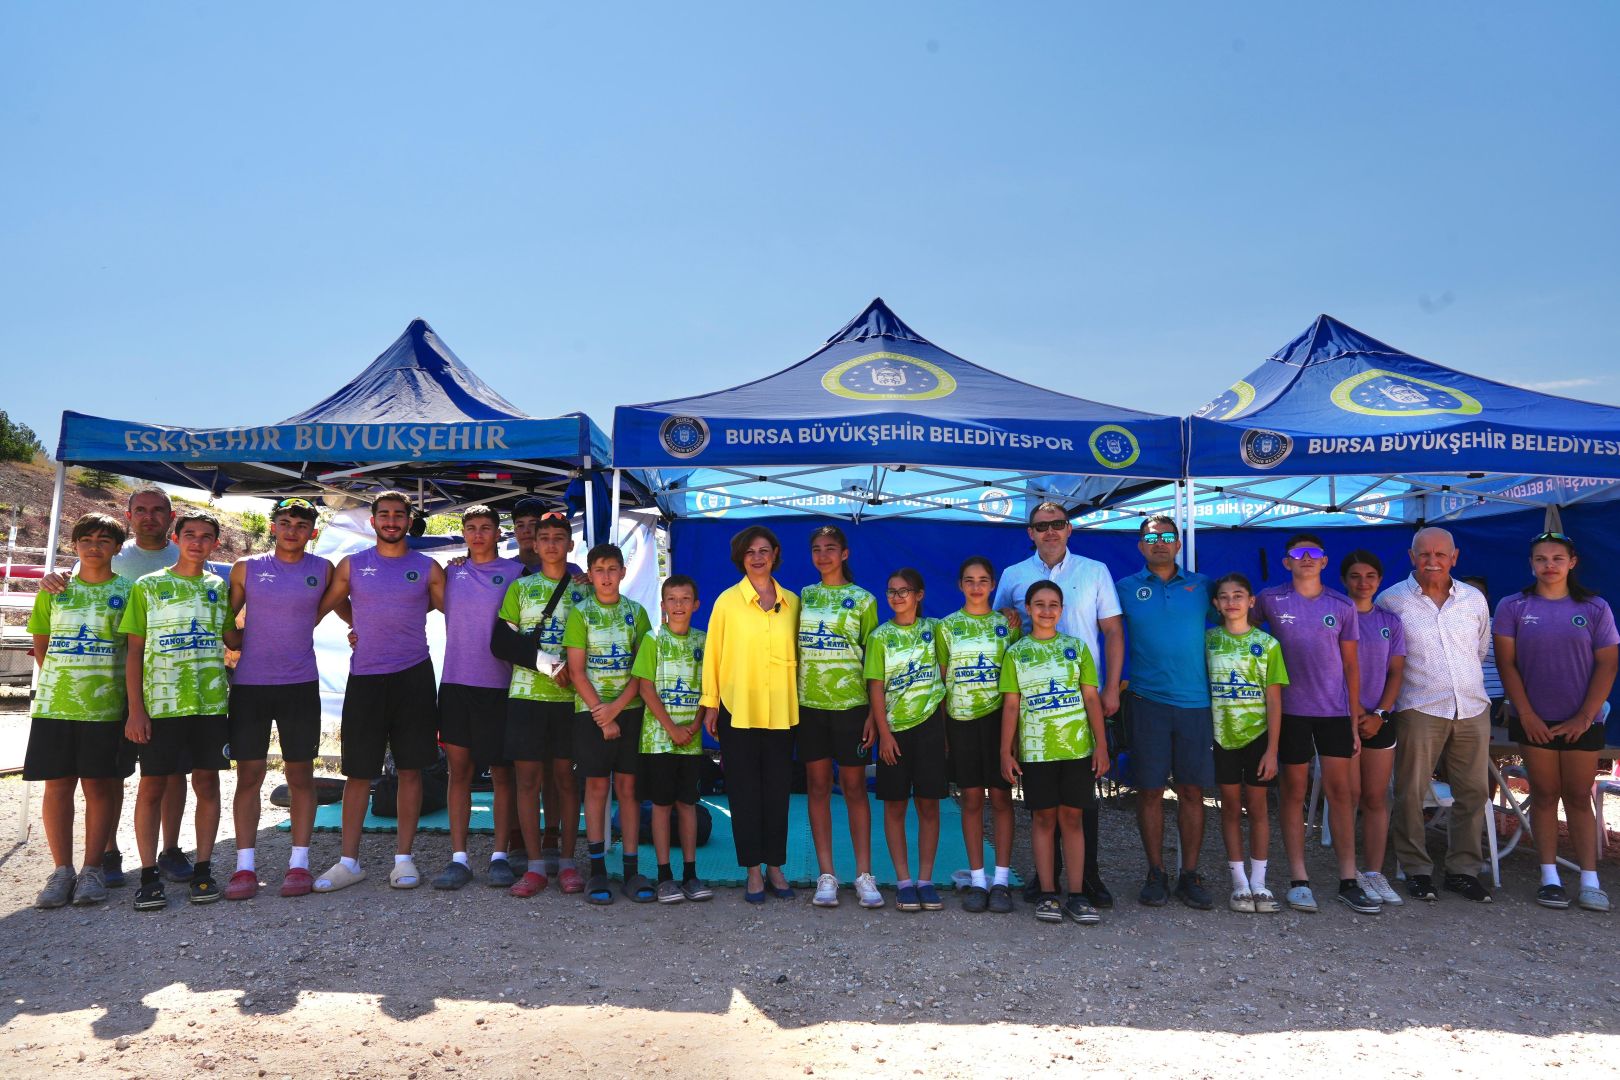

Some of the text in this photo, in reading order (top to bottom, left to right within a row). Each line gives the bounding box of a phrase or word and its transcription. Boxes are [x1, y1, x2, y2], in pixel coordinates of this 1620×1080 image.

[726, 429, 793, 444] BURSA
[799, 421, 924, 446] BÜYÜKŞEHİR
[930, 427, 1074, 451] BELEDİYESPOR
[1308, 437, 1375, 454] BURSA
[1380, 428, 1506, 454] BÜYÜKŞEHİR
[159, 637, 186, 646] CANOE
